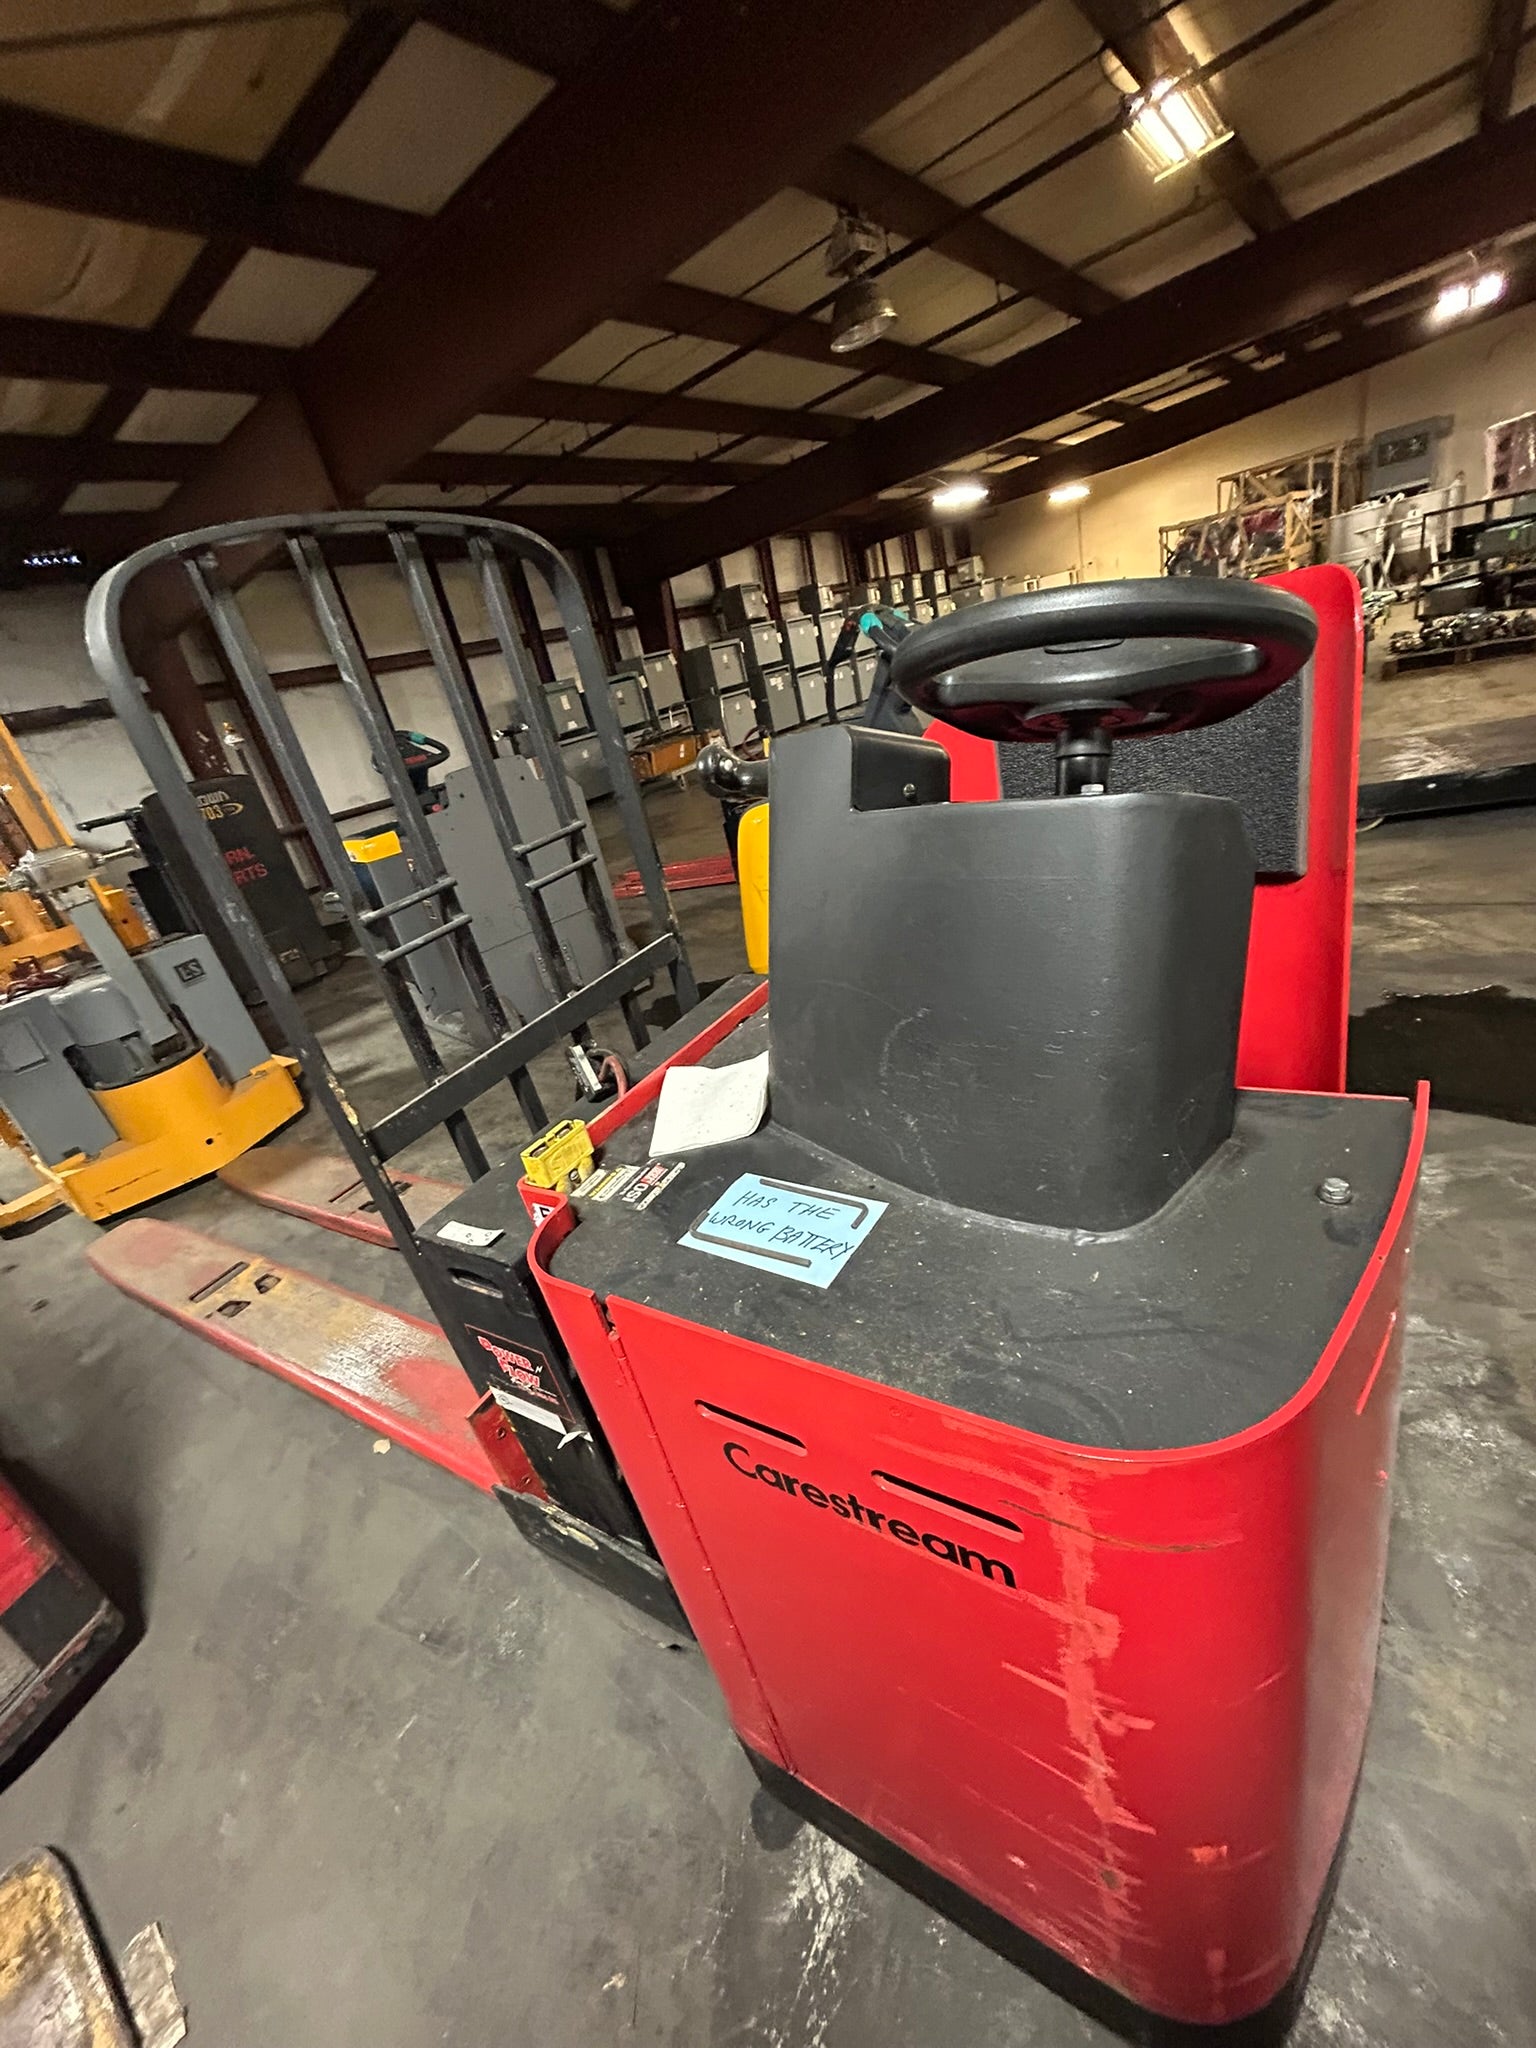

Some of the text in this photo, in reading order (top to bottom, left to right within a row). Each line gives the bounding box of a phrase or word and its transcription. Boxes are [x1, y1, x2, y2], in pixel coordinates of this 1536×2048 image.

[622, 1182, 650, 1203] ISO
[732, 1190, 841, 1220] HAS THE
[708, 1211, 856, 1260] WRONG BATTERY
[722, 1441, 1018, 1590] Carestream
